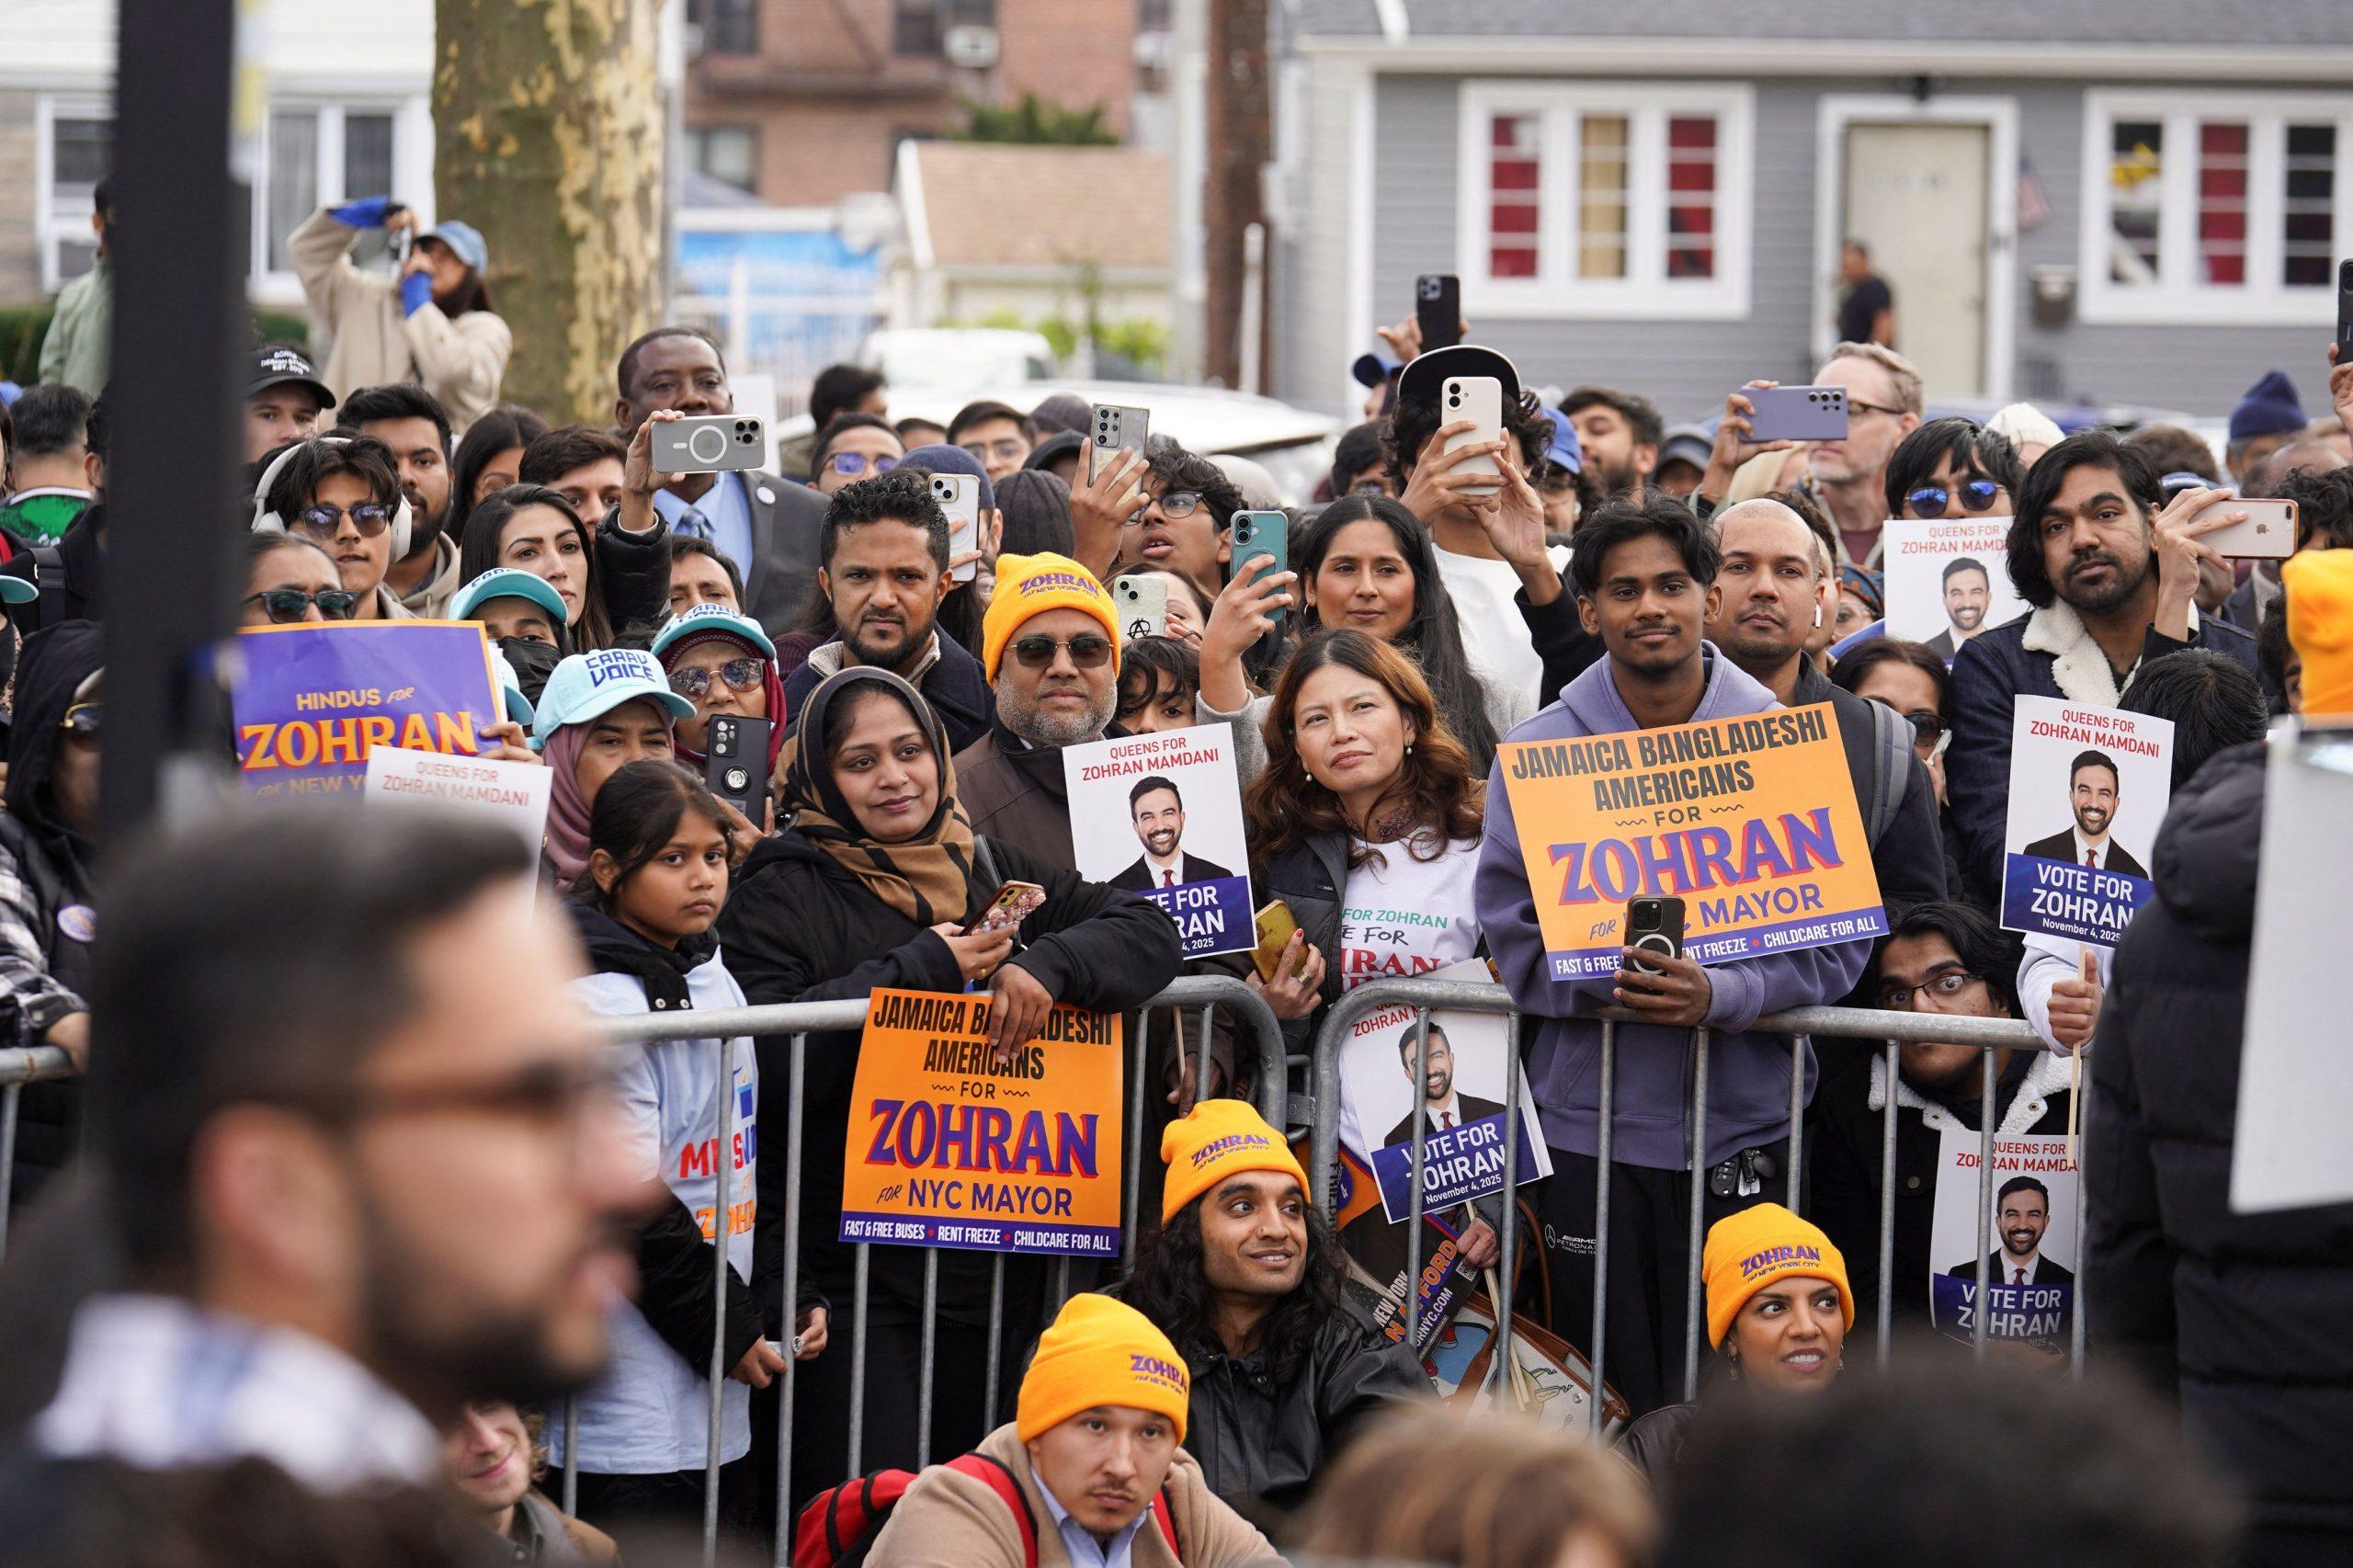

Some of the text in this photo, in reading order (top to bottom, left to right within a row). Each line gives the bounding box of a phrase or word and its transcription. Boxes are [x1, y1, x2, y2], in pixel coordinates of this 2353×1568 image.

[1929, 525, 2000, 538] QUEENS FOR
[1901, 540, 2008, 554] ZOHRAN MAMD
[1019, 573, 1099, 597] ZOHRAN
[590, 664, 655, 687] VOICE
[297, 687, 415, 710] HINDUS FOR
[2062, 710, 2135, 733] QUEENS FOR
[240, 711, 479, 771] ZOHRAN
[1110, 737, 1187, 759] QUEENS FOR
[1512, 710, 1827, 779] JAMAICA BANGLADESHI
[2030, 721, 2160, 758] ZOHRAN MAMDANI
[415, 761, 499, 783] QUEENS FOR
[1082, 748, 1219, 781] ZOHRAN MAMDANI
[290, 775, 343, 796] NEW
[382, 775, 447, 798] ZOHRAN
[450, 782, 531, 807] MAMDANI
[1593, 761, 1755, 812] AMERICANS
[1654, 806, 1702, 827] FOR
[1547, 806, 1845, 906] ZOHRAN
[2038, 863, 2132, 903] VOTE FOR
[1176, 885, 1219, 911] FOR
[1589, 922, 1616, 940] FOR
[1700, 883, 1824, 927] MAYOR
[2031, 888, 2133, 930] ZOHRAN
[1176, 909, 1225, 939] RAN
[1342, 909, 1449, 929] FOR ZOHRAN
[2042, 918, 2120, 942] November 4, 2025
[1181, 937, 1214, 951] 4, 2025
[1364, 927, 1409, 946] FOR
[1704, 937, 1749, 960] FREEZE
[1763, 925, 1828, 948] CHILDCARE
[1831, 919, 1854, 936] FOR
[1857, 915, 1879, 933] ALL
[1556, 955, 1621, 974] FAST & FREE
[873, 995, 968, 1034] JAMAICA
[1353, 1008, 1409, 1037] ZOHRAN
[924, 1040, 1044, 1080] AMERICANS
[960, 1081, 995, 1099] FOR
[864, 1098, 1099, 1179] ZOHRAN
[1191, 1134, 1270, 1167] ZOHRAN
[1457, 1122, 1499, 1150] FOR
[1991, 1141, 2066, 1155] QUEENS FOR
[2023, 1158, 2078, 1172] MAMDA
[877, 1178, 1073, 1217] FOR NYC MAYOR
[1426, 1174, 1502, 1205] November 4, 2025
[845, 1220, 1111, 1251] FAST & FREE BUSES RENT FREEZE CHILDCARE FOR ALL
[1557, 1239, 1597, 1250] PETRONA
[1740, 1244, 1821, 1278] ZOHRAN
[1758, 1266, 1778, 1278] NEW
[1779, 1261, 1801, 1269] YORK
[1802, 1261, 1820, 1269] CITY
[1962, 1284, 2062, 1309] VTE FOR
[1372, 1297, 1396, 1327] NEW
[1957, 1305, 2061, 1337] ZHRAN
[1131, 1354, 1188, 1394] ZOHRA
